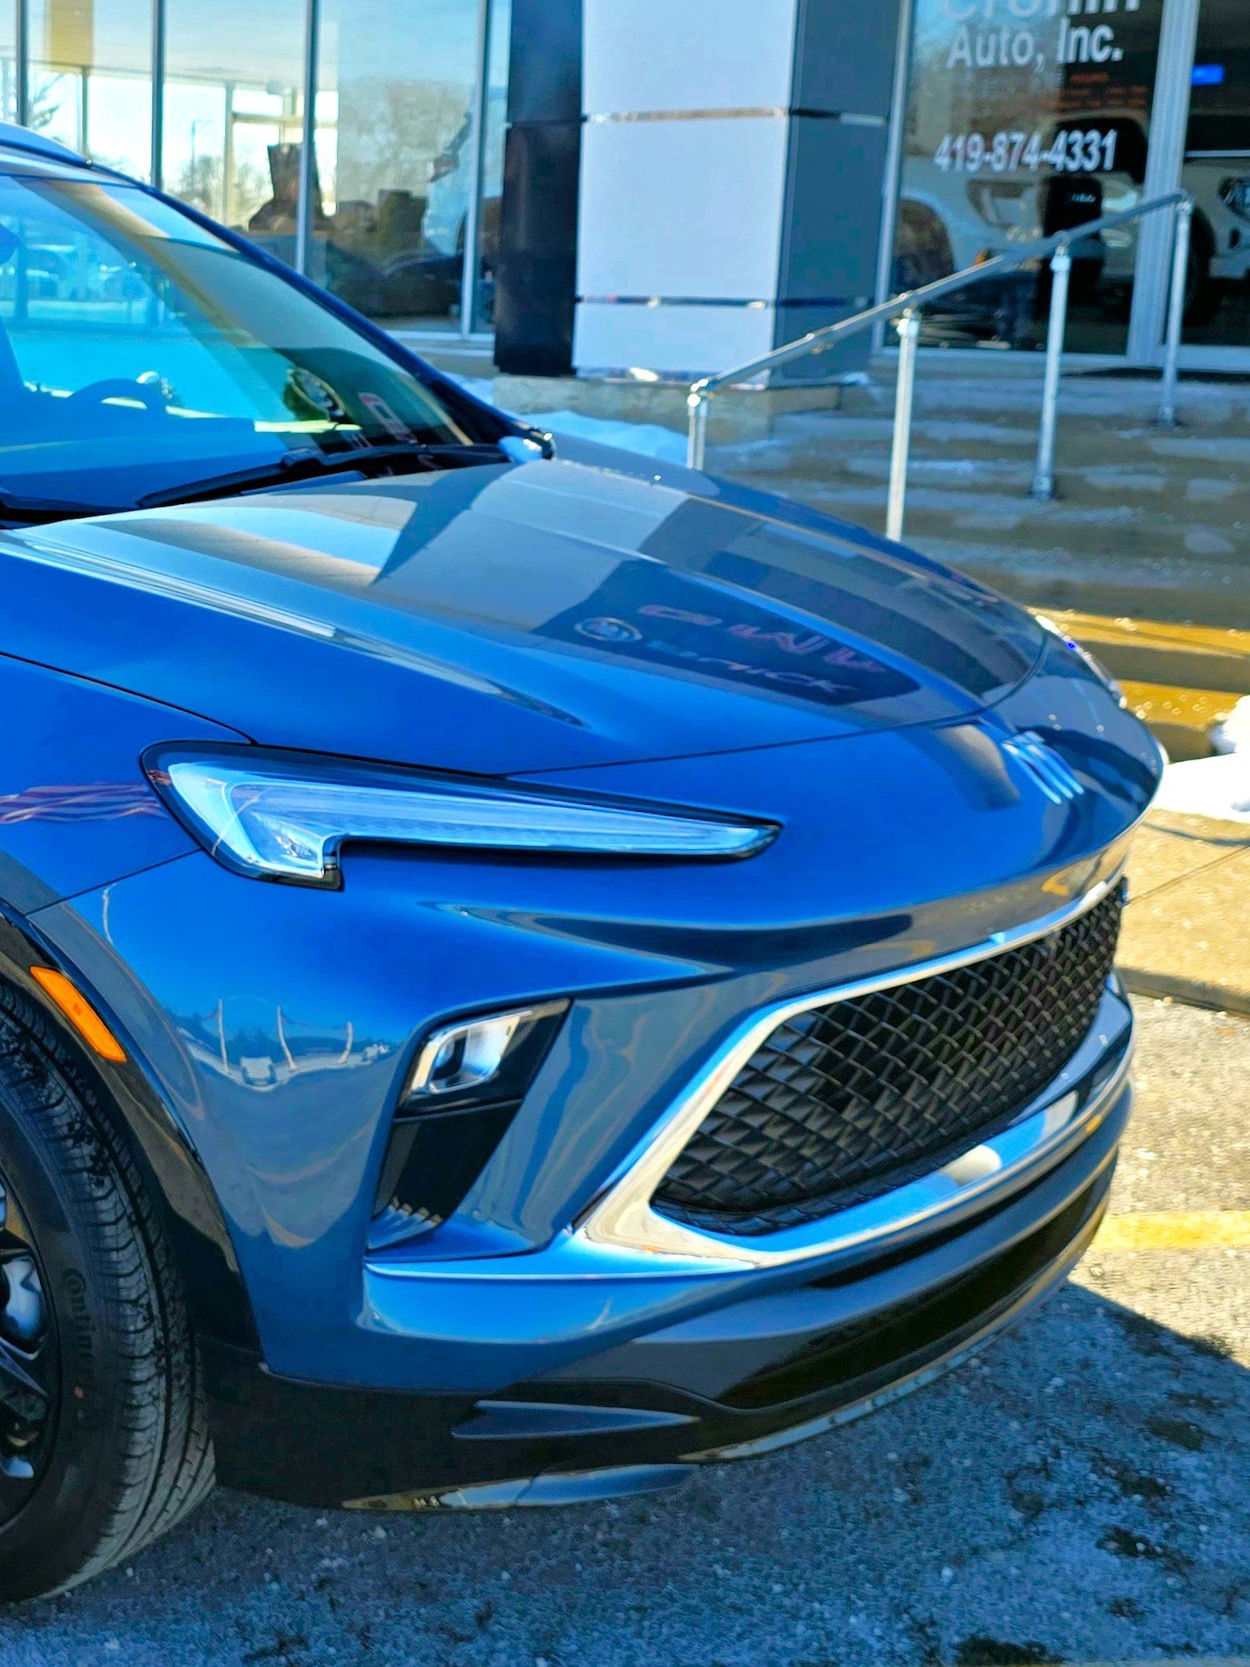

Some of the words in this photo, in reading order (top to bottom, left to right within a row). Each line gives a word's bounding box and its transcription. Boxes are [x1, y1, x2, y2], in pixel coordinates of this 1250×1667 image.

[946, 24, 1045, 73] Auto,
[1056, 16, 1124, 63] Inc.
[934, 129, 1118, 173] 419-874-4331
